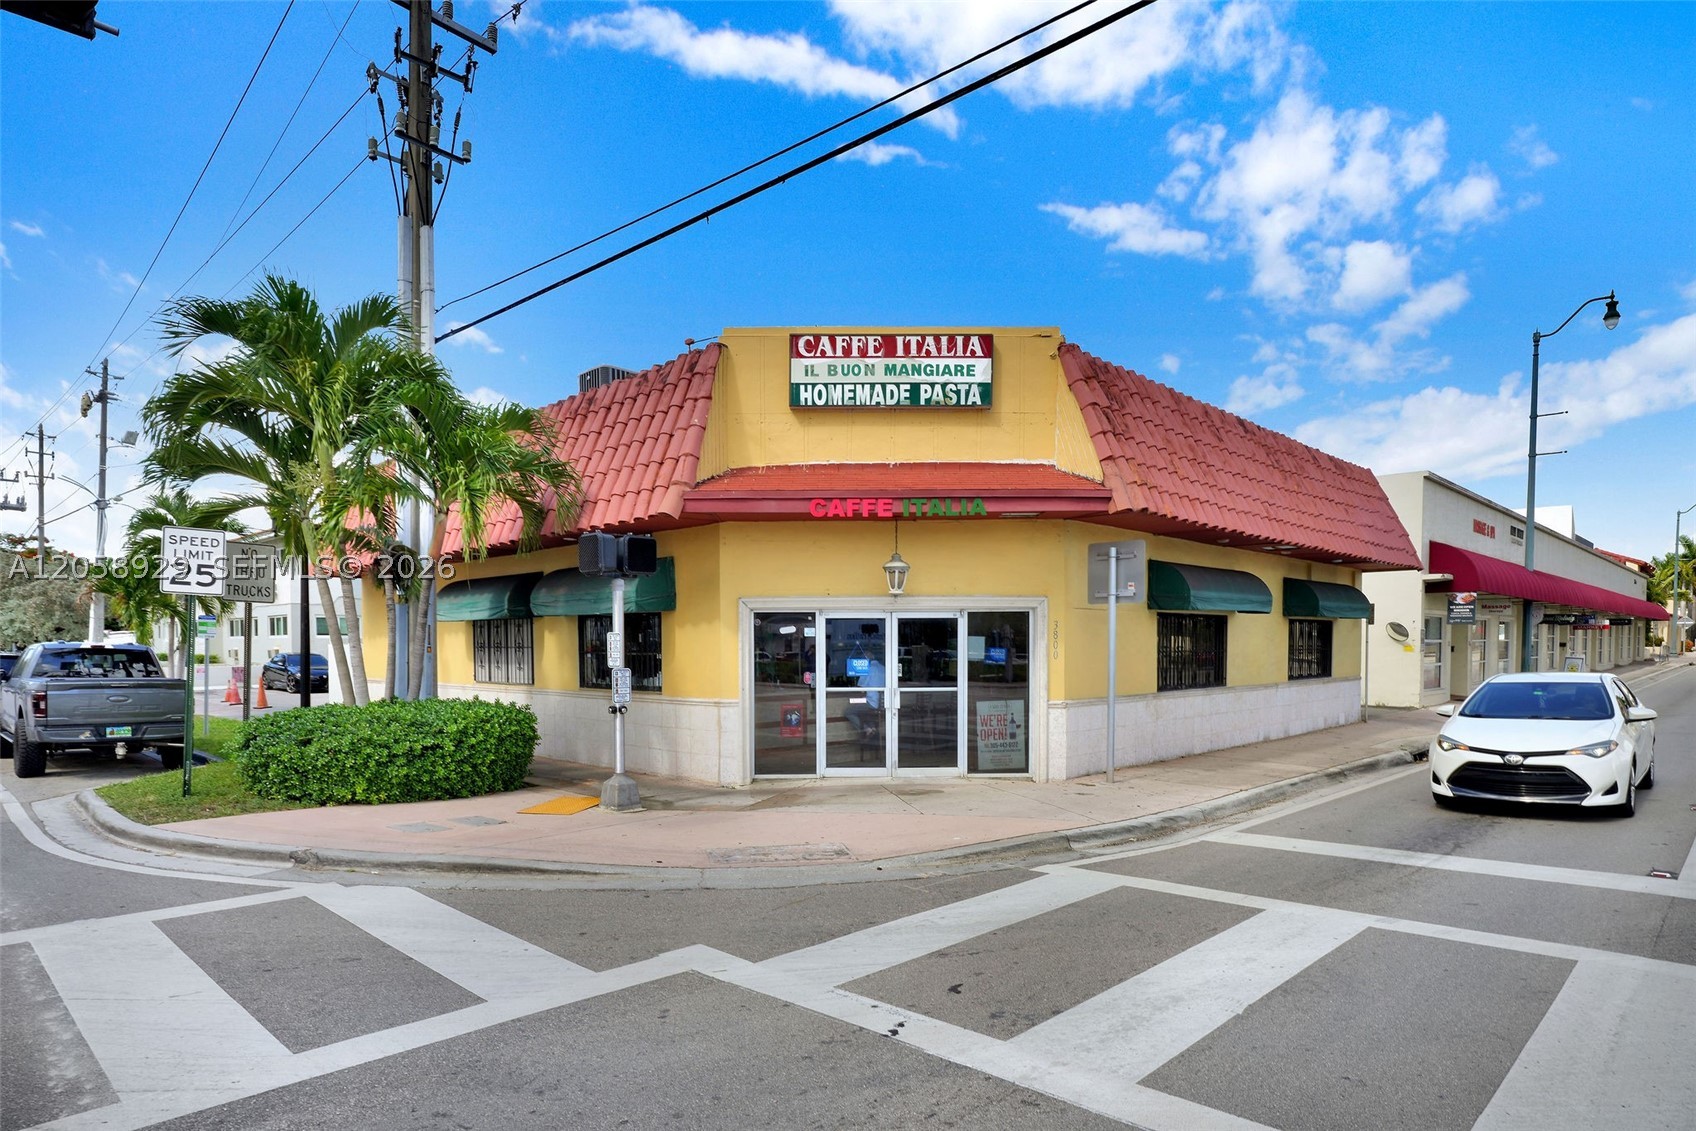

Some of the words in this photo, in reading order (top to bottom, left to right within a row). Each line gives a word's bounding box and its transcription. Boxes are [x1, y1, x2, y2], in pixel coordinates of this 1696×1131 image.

[797, 335, 884, 357] CAFFE
[895, 335, 985, 357] ITALIA
[804, 364, 820, 377] IL
[827, 363, 875, 377] BUON
[884, 363, 976, 377] MANGIARE
[799, 383, 911, 406] HOMEMADE
[920, 383, 982, 406] PASTA
[808, 497, 894, 518] CAFFE
[902, 497, 988, 517] ITALIA
[168, 534, 221, 548] SPEED
[173, 548, 215, 561] LIMIT
[241, 548, 258, 559] NO
[169, 562, 218, 588] 25
[235, 566, 266, 579] THRU
[226, 583, 271, 598] TRUCKS
[979, 713, 1008, 728] WE'RE
[980, 728, 1008, 742] OPEN!
